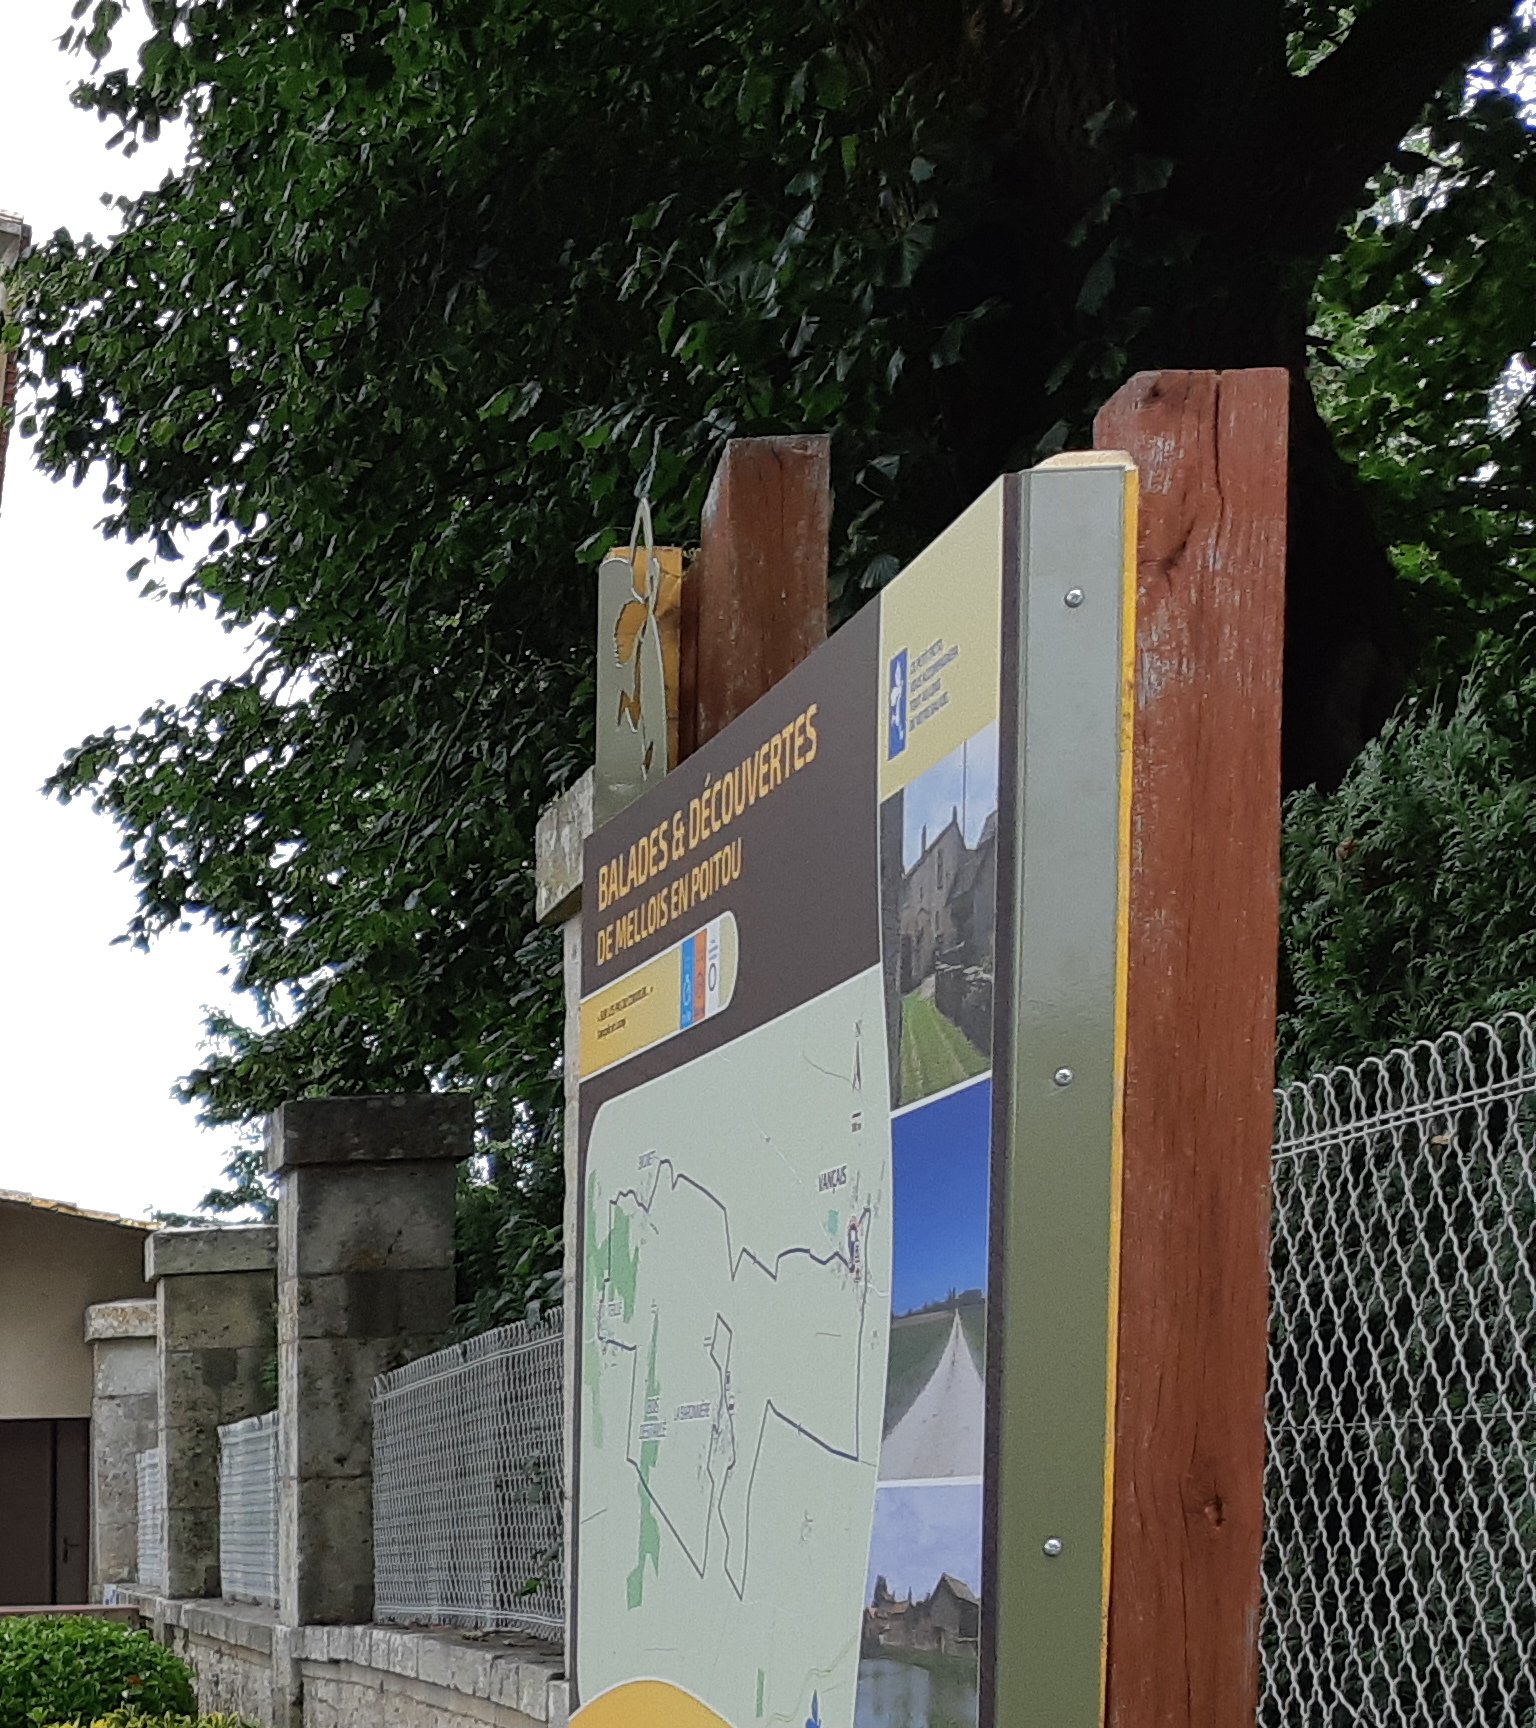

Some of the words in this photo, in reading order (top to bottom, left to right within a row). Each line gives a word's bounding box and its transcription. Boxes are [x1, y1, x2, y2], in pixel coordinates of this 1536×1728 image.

[598, 820, 669, 912] BALADES
[672, 810, 685, 861] &
[689, 703, 818, 850] DÉCOUVERTES
[596, 924, 613, 966] DE
[615, 887, 669, 955] MELLOIS
[671, 874, 689, 919] EN
[691, 837, 742, 907] POITOU
